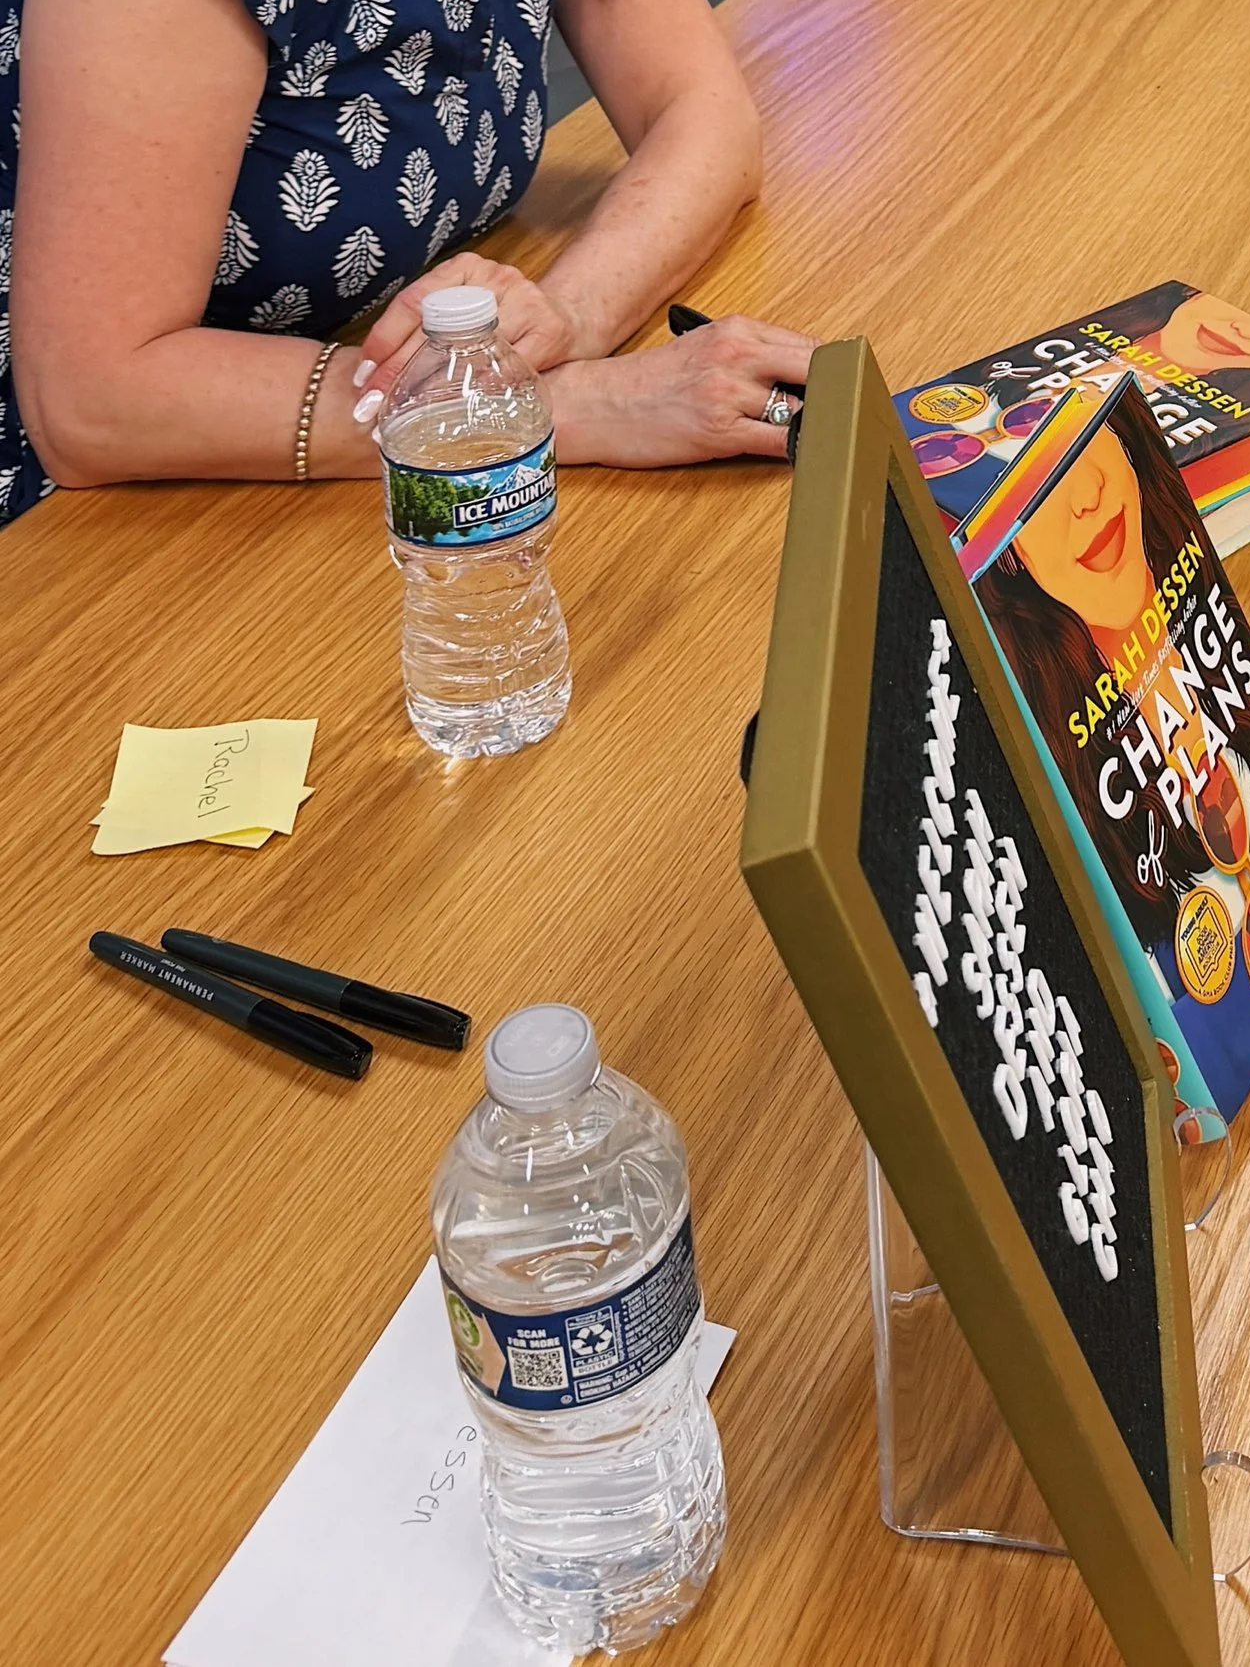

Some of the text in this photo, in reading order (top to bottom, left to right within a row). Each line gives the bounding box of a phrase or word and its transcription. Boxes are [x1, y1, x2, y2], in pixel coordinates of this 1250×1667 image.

[1078, 321, 1163, 368] SARAH
[1033, 338, 1218, 446] CHAGE
[458, 469, 556, 524] ICE MOUNTAI
[1067, 530, 1208, 749] SARAH DESSEN
[1098, 583, 1235, 822] CHANGE
[197, 728, 250, 819] Rachel
[1135, 809, 1165, 888] of
[118, 949, 215, 1003] PERMANENT MARKER
[507, 1335, 561, 1349] FOR MORE
[516, 1328, 547, 1340] SCAN
[574, 1350, 616, 1368] PLASTIC
[401, 1424, 478, 1525] essen
